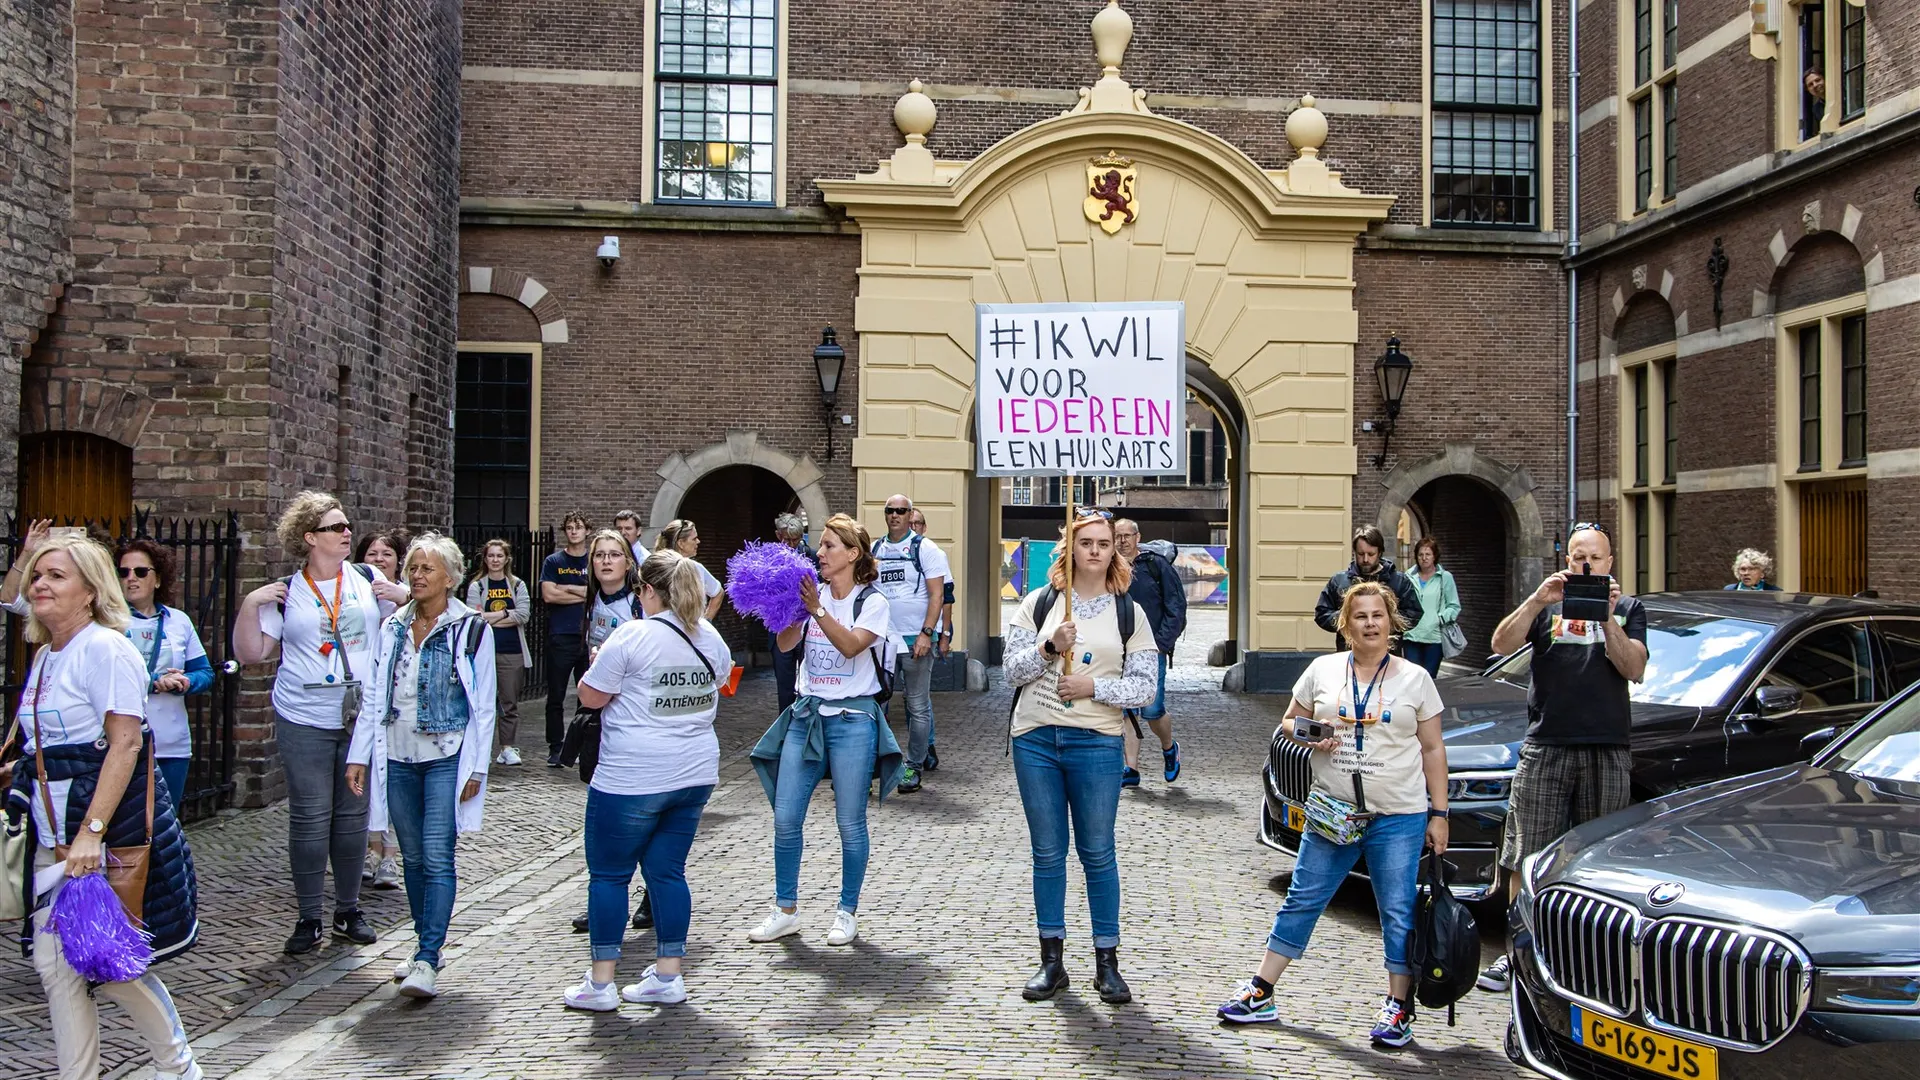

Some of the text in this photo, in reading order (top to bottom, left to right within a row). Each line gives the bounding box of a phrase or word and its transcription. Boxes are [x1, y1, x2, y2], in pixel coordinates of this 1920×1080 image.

[995, 367, 1088, 398] VOOR
[999, 396, 1171, 437] IEDEREEN
[1055, 438, 1173, 469] HUISARTS
[881, 572, 904, 581] 7800
[655, 694, 712, 708] PATIËNTEN
[1592, 1020, 1700, 1077] G-169-JS
